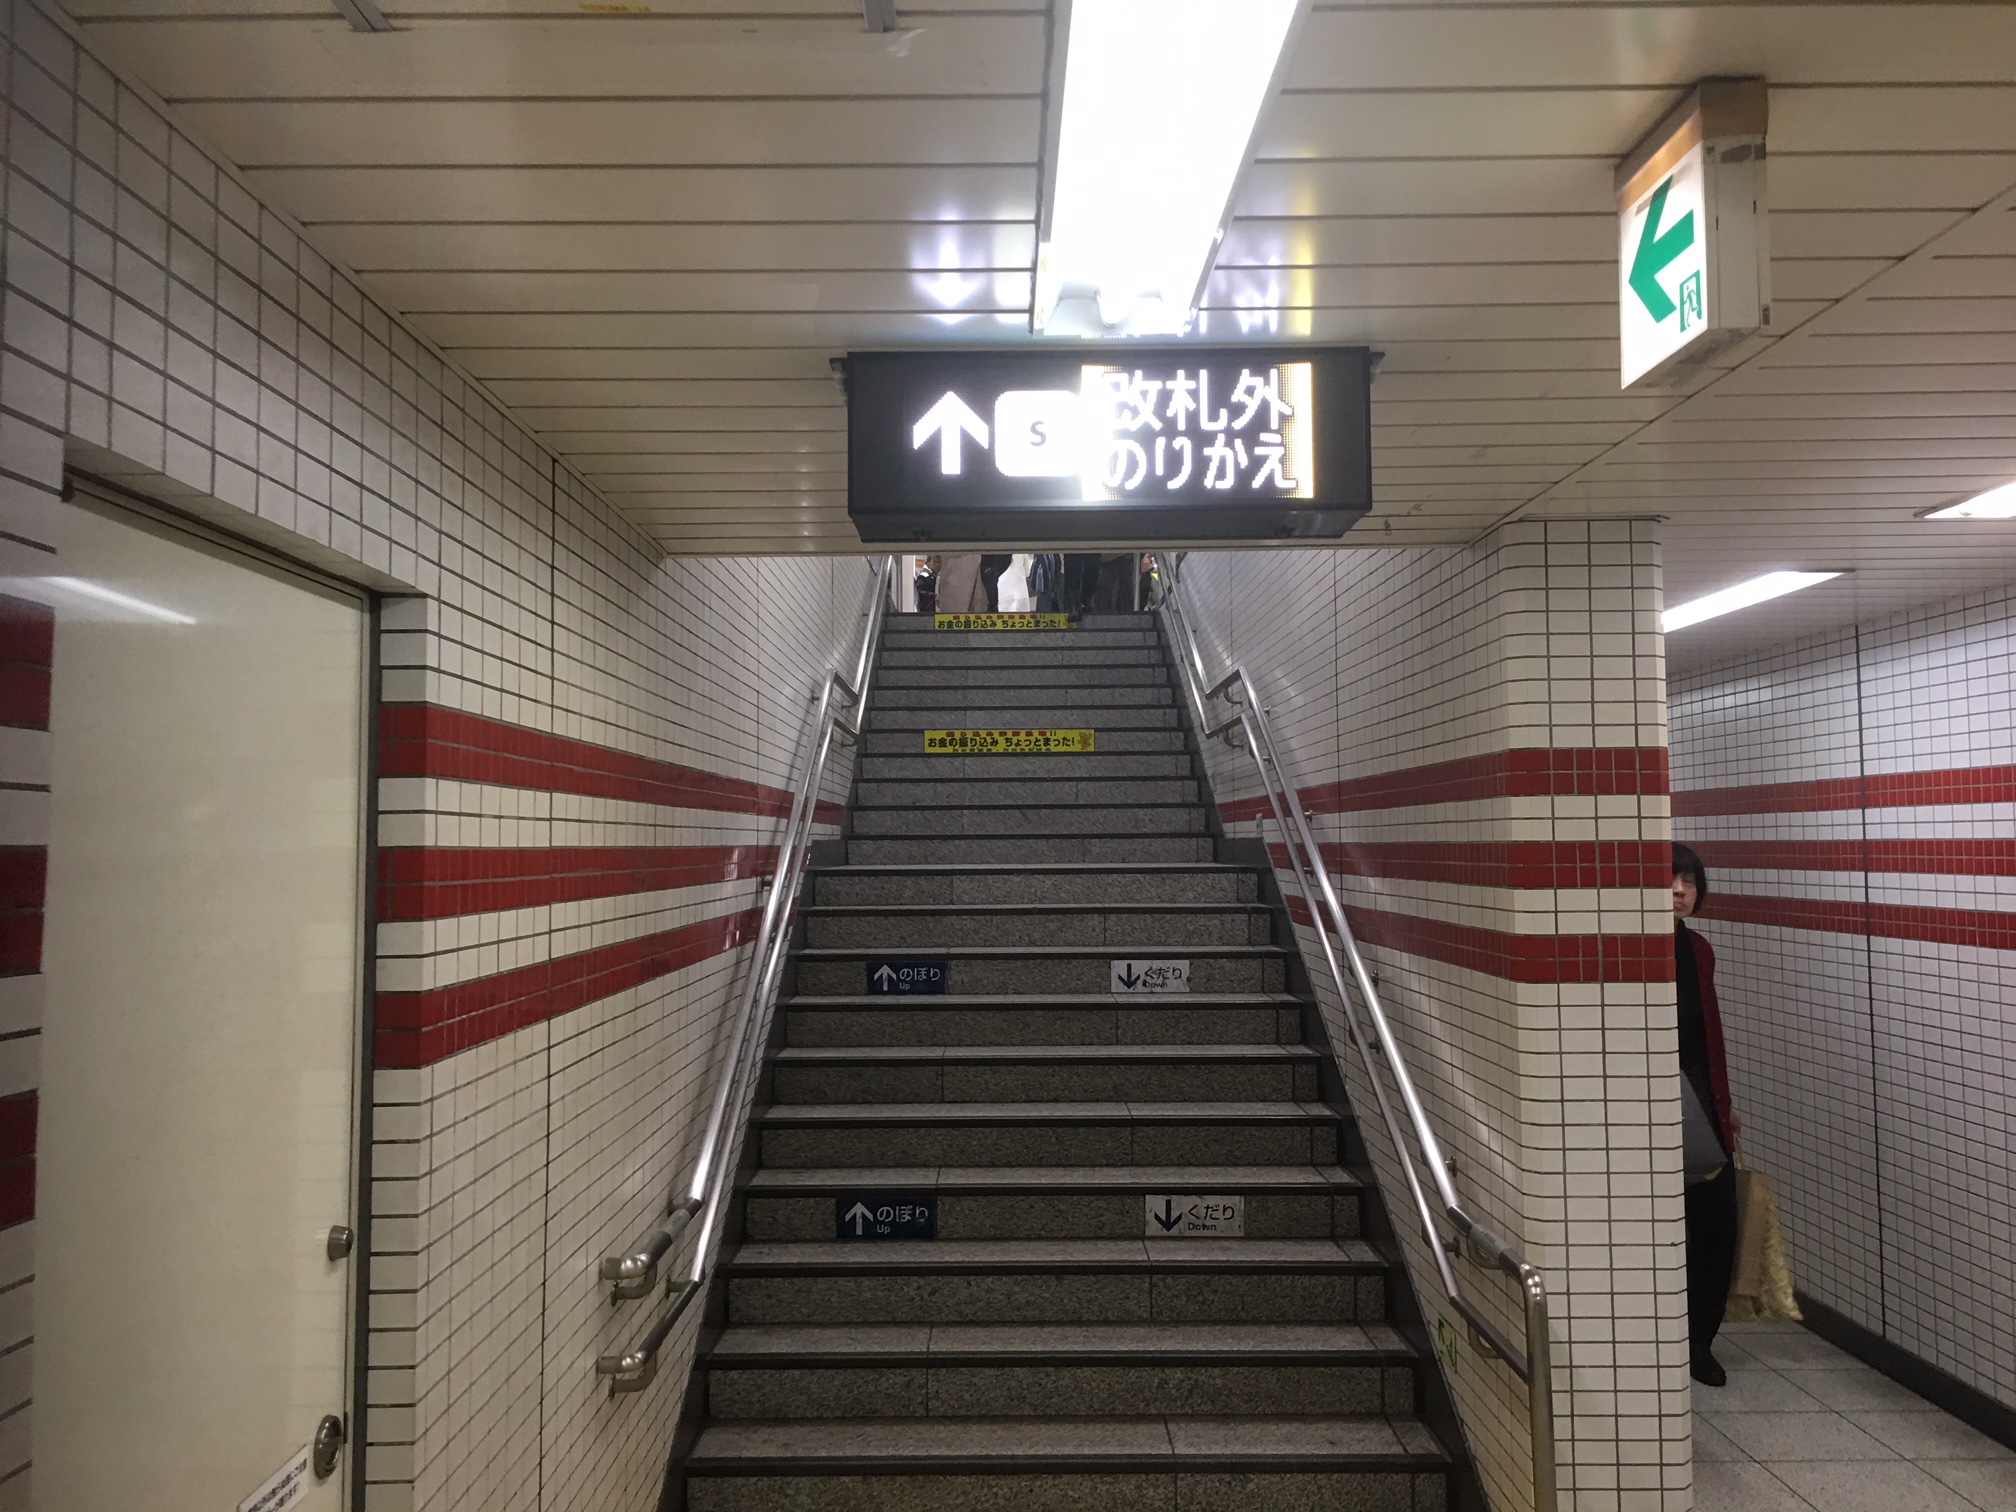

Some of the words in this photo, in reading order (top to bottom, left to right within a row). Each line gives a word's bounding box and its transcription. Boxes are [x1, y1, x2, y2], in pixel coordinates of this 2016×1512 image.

[1101, 368, 1294, 431] 改札外
[1102, 432, 1298, 490] のりかえ
[899, 967, 941, 981] のぼり
[1144, 966, 1183, 980] くだり
[899, 982, 911, 991] Up
[1144, 981, 1168, 989] Down
[876, 1205, 929, 1223] のぼり
[1187, 1204, 1235, 1221] くだり
[876, 1224, 891, 1235] Up
[1187, 1222, 1217, 1231] Down
